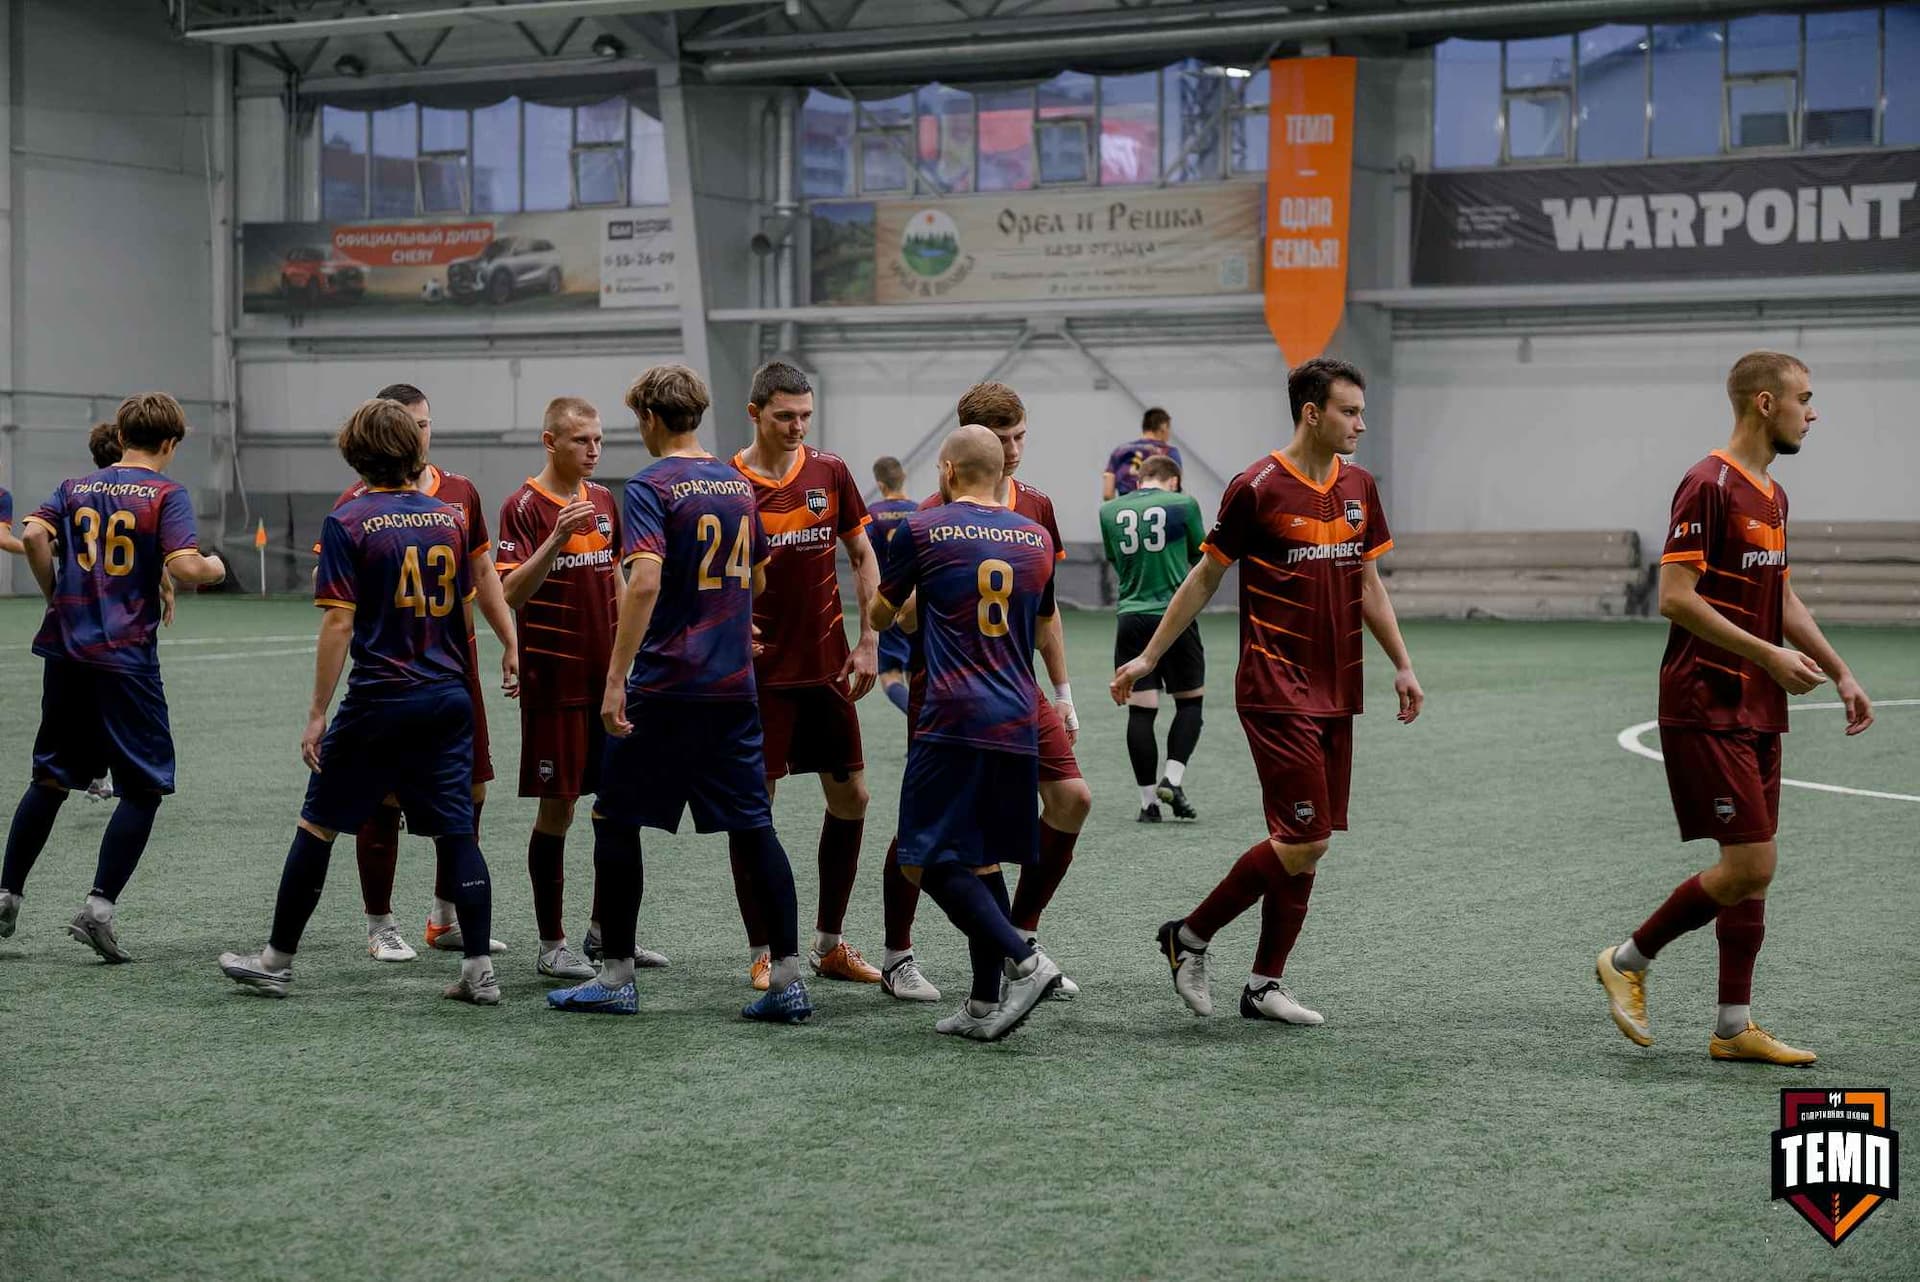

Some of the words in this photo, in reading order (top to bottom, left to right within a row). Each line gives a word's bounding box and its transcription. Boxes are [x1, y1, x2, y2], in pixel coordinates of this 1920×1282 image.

[1286, 115, 1334, 144] ТЕМП
[1280, 197, 1332, 229] ОДНА
[335, 228, 441, 248] ОФИЦИАЛЬНЫЙ
[444, 228, 491, 244] ДИЛЕР
[75, 507, 136, 576] 36
[697, 513, 752, 590] 24
[929, 525, 1045, 548] КРАСНОЯРСК
[1116, 507, 1167, 555] 33
[395, 544, 457, 618] 43
[977, 558, 1014, 638] 8
